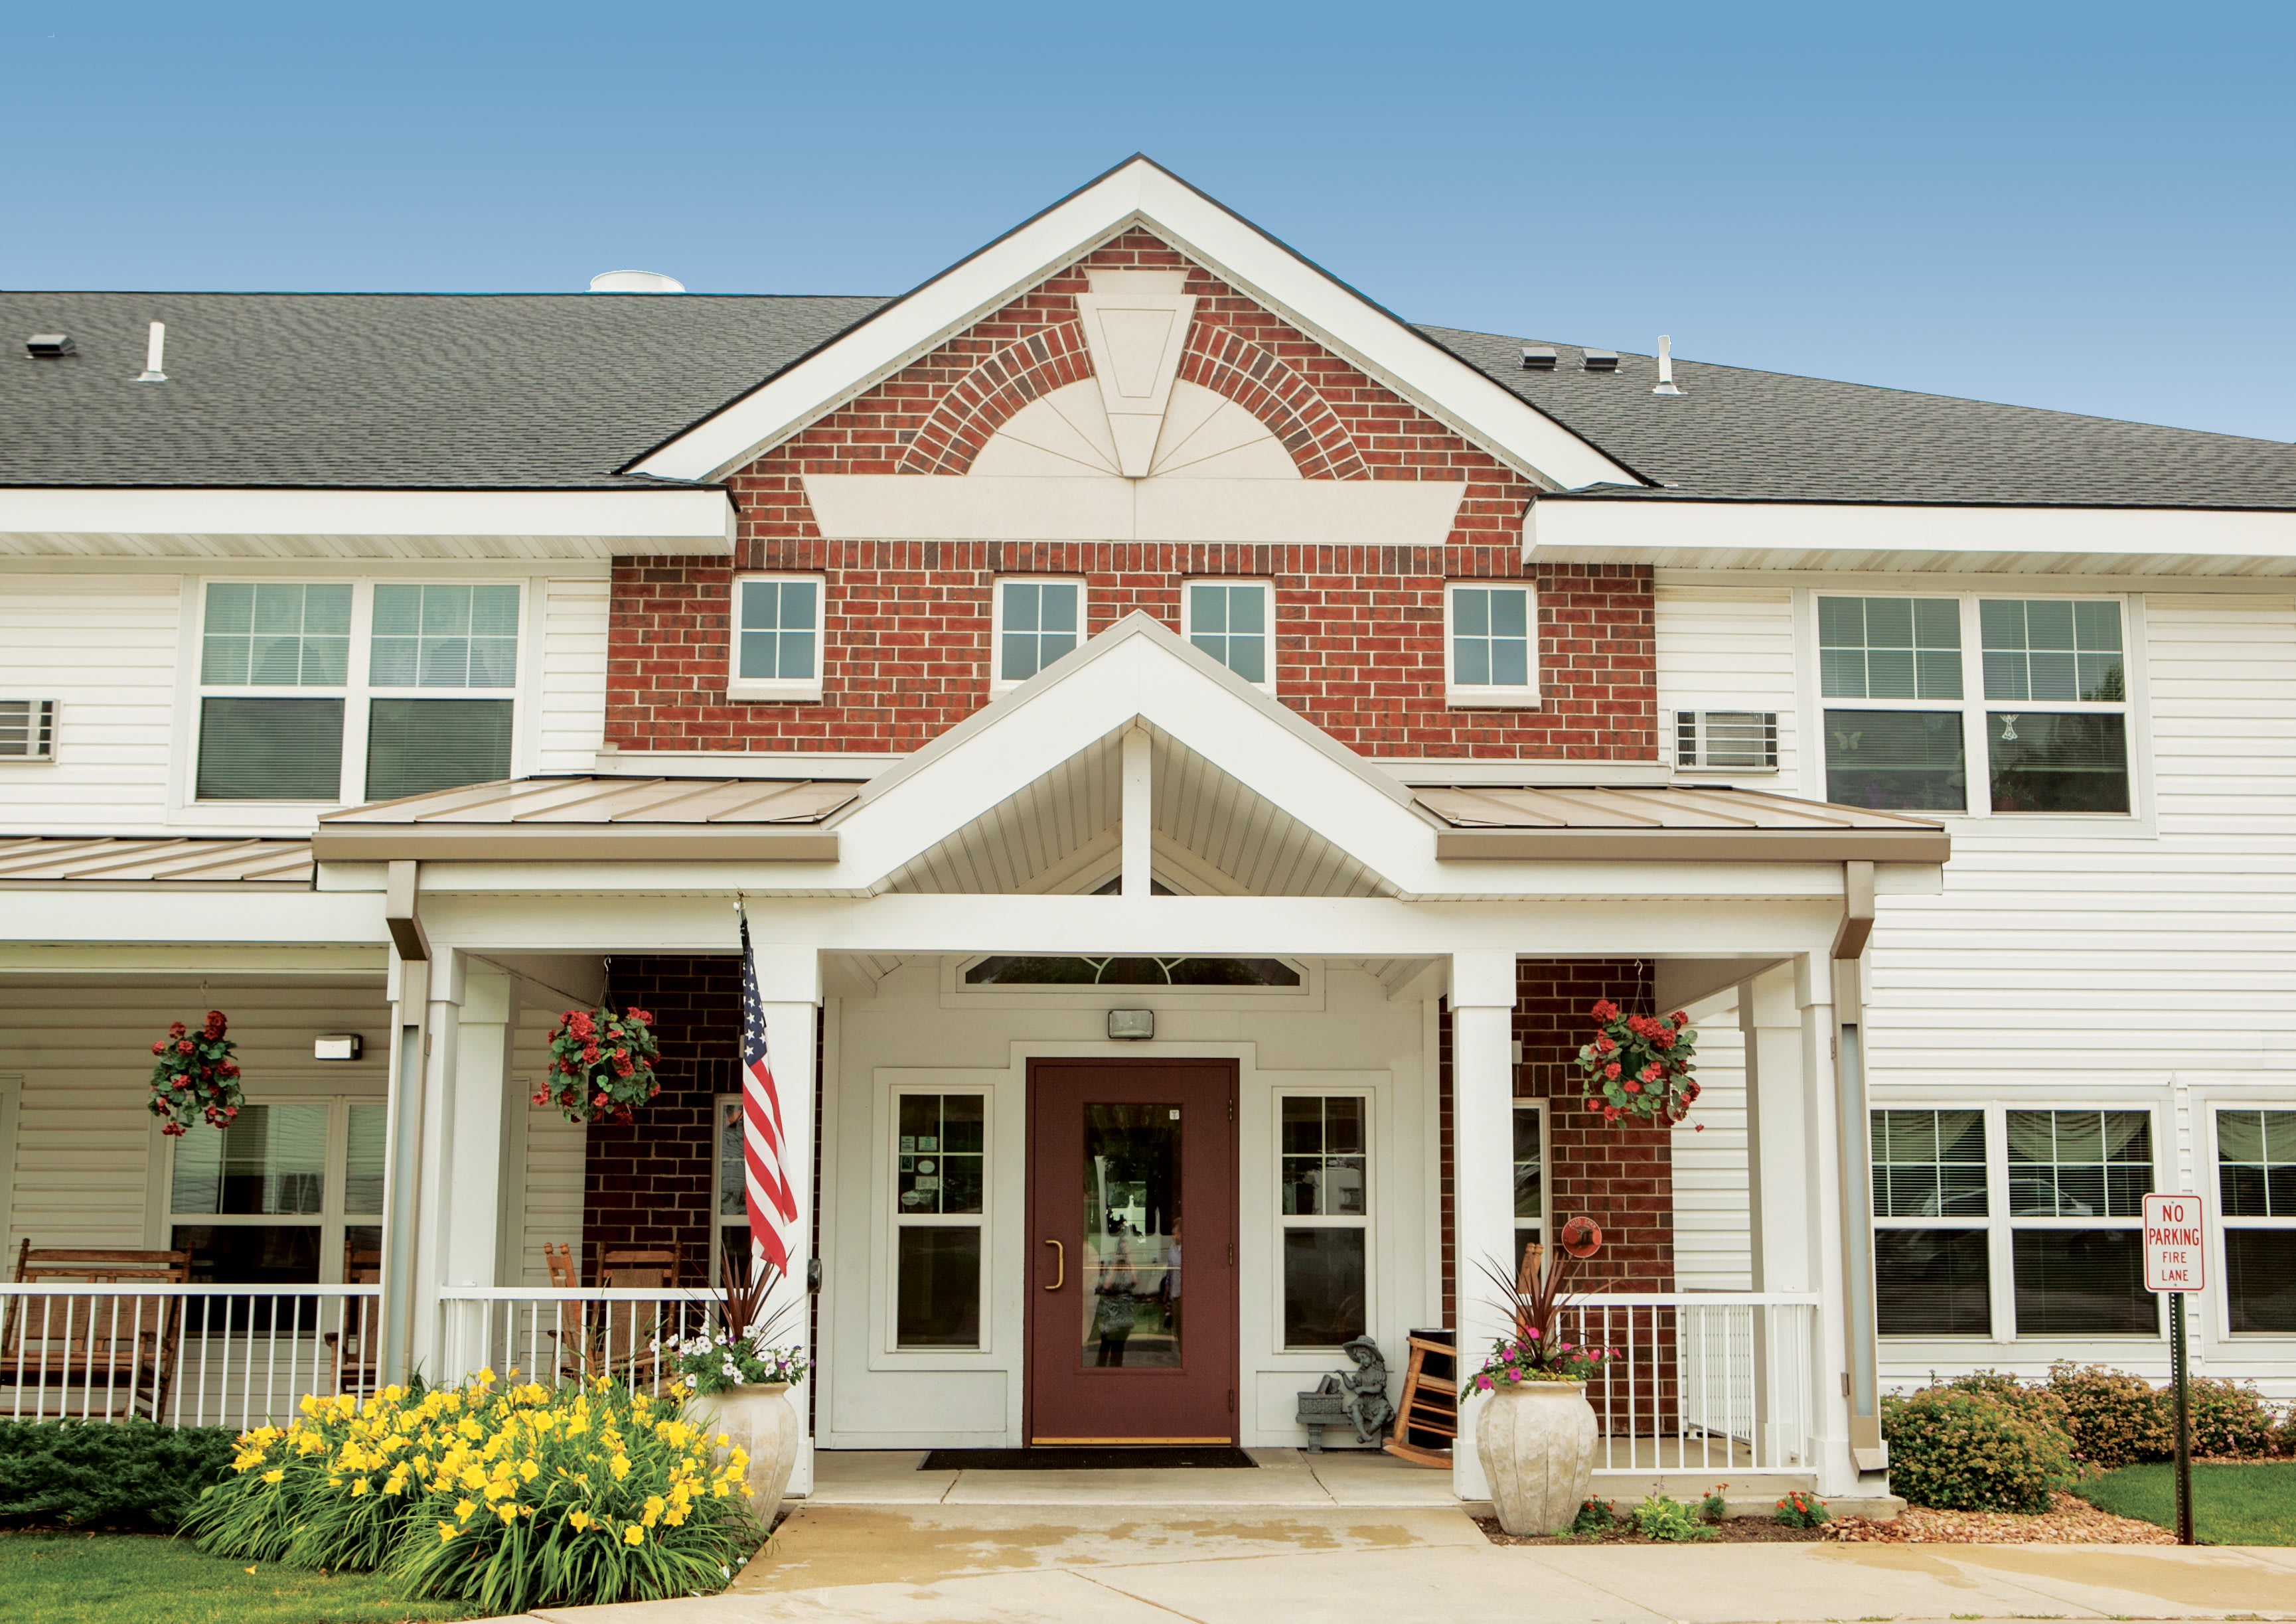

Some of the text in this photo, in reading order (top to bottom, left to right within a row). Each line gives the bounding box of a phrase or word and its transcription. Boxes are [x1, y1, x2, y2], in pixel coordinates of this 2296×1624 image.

[2163, 1205, 2184, 1222] NO
[1569, 1218, 1581, 1228] AUTO
[2149, 1228, 2199, 1246] PARKING
[2163, 1252, 2186, 1263] FIRE
[2162, 1270, 2188, 1281] LANE
